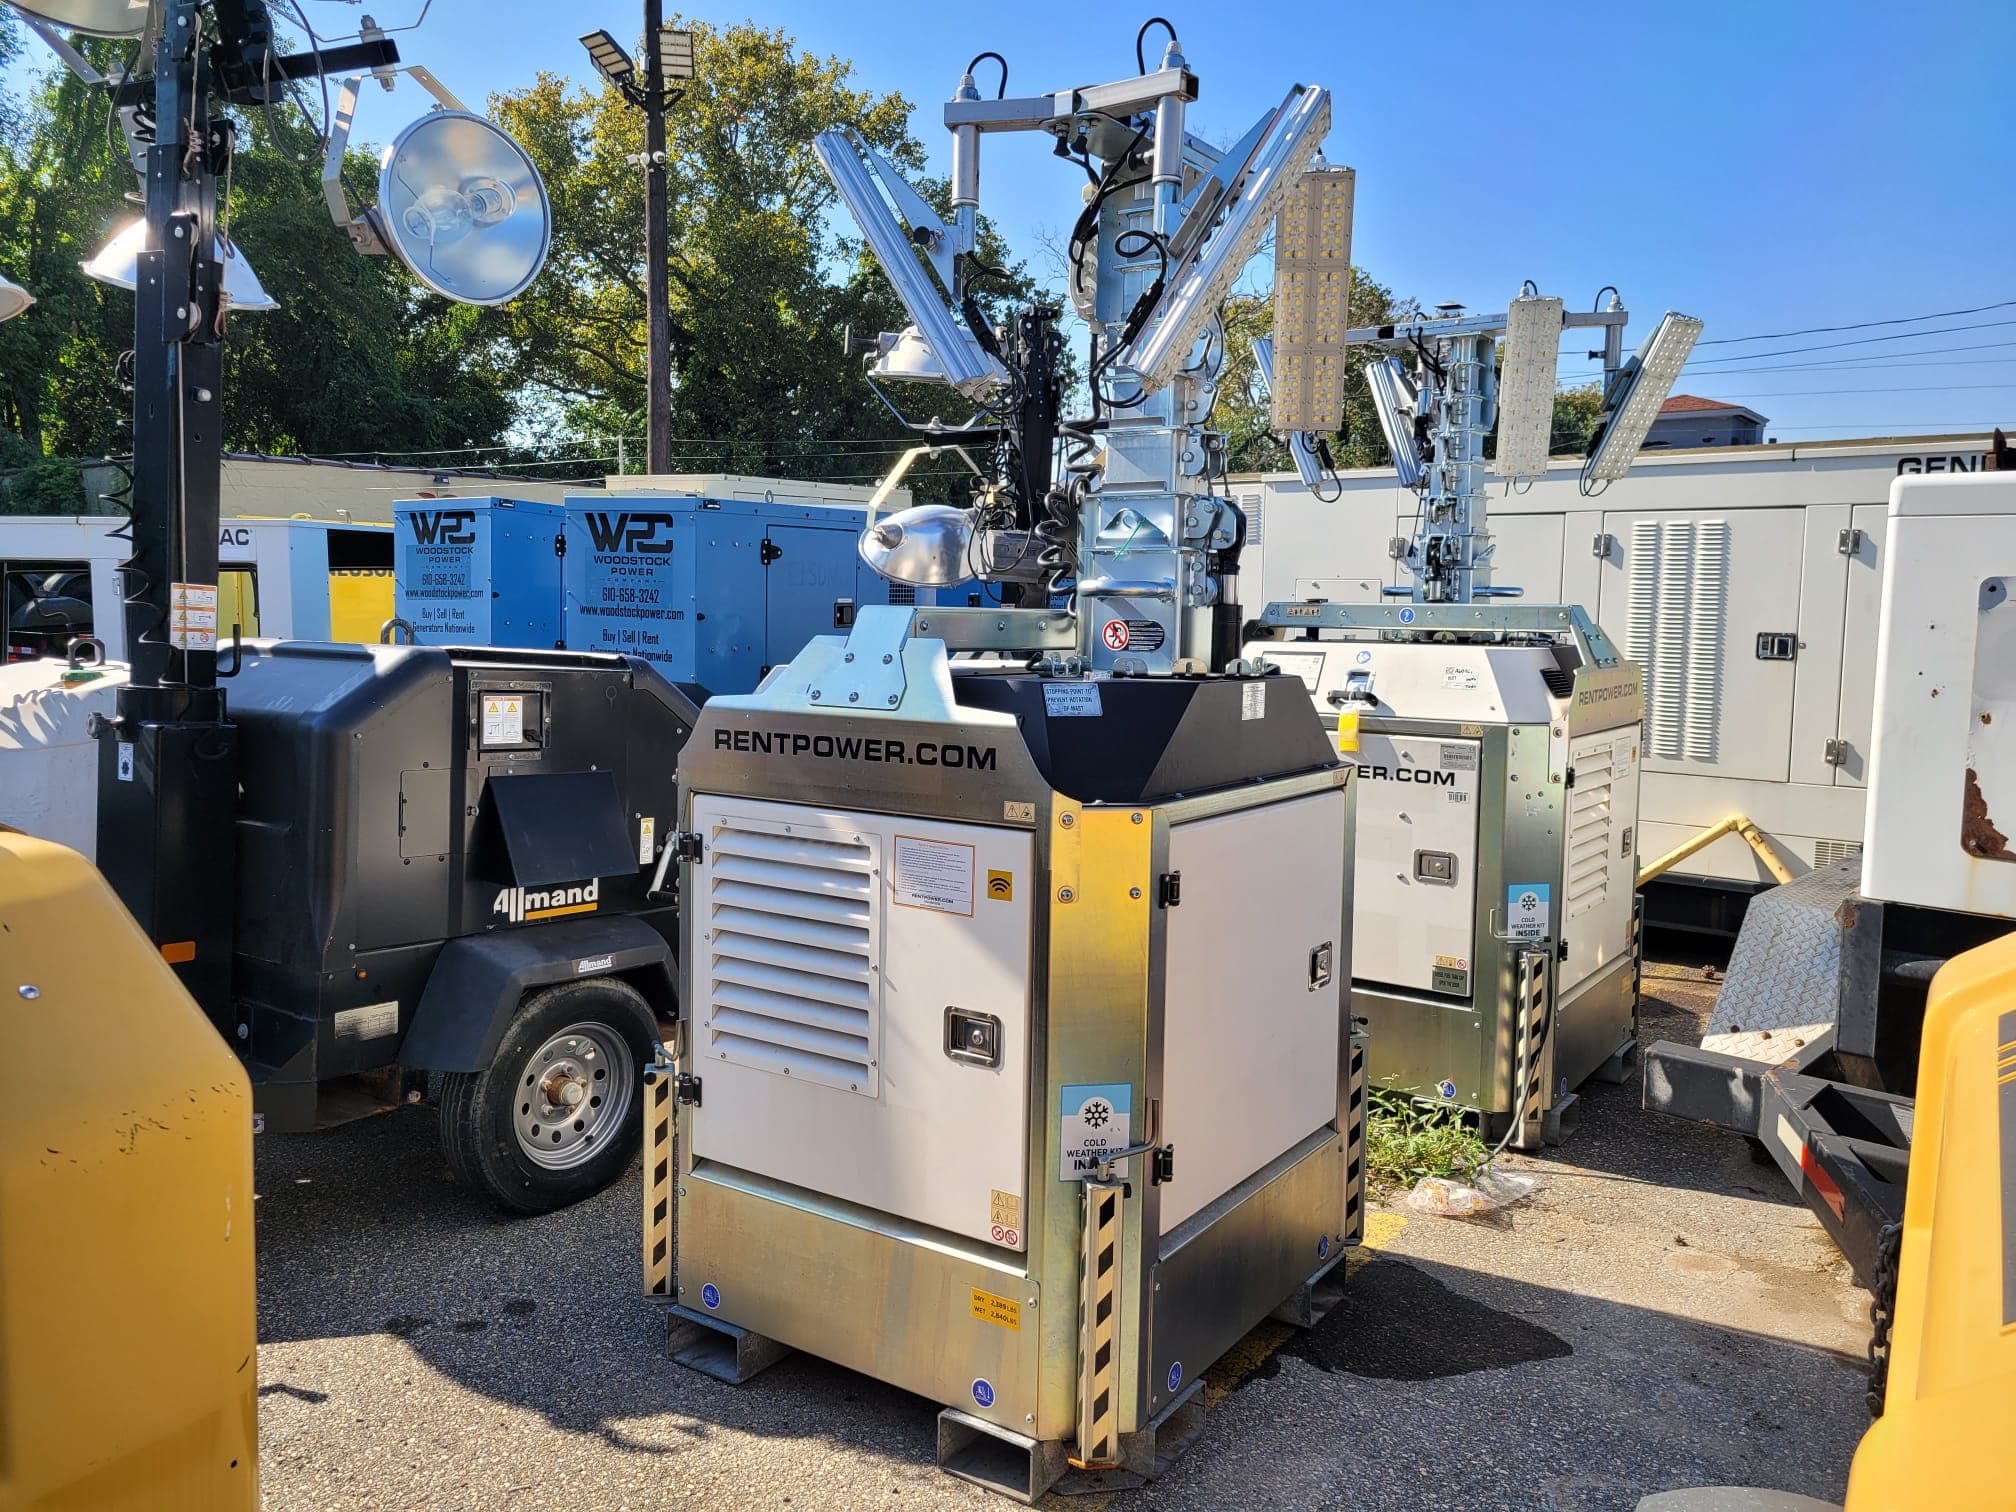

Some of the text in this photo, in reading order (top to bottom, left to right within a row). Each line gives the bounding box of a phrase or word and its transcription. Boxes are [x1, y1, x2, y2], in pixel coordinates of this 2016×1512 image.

[416, 546, 473, 555] WOODSTOCK
[594, 555, 670, 566] WOODSTOCK
[611, 567, 653, 577] POWER
[422, 573, 465, 586] 610-658-3242
[406, 587, 483, 600] www.woodstockpower.com
[602, 587, 660, 604] 610-658-3242
[422, 608, 432, 620] Buy
[437, 608, 447, 619] Sell
[452, 609, 465, 619] Rent
[579, 604, 684, 621] www.woodstockpower.com
[413, 622, 475, 633] Generators Nationwide
[602, 629, 616, 644] Buy
[622, 631, 635, 643] Sell
[642, 631, 659, 645] Rent
[1578, 682, 1638, 706] RENTPOWER.COM
[713, 728, 996, 770] RENTPOWER.COM
[1357, 765, 1455, 786] ER.COM
[493, 877, 599, 922] Allmand
[1515, 929, 1541, 937] INSIDE
[578, 955, 613, 971] Allmand
[1083, 1138, 1107, 1147] COLD
[1066, 1148, 1108, 1158] WEATHER
[973, 1305, 986, 1315] WET
